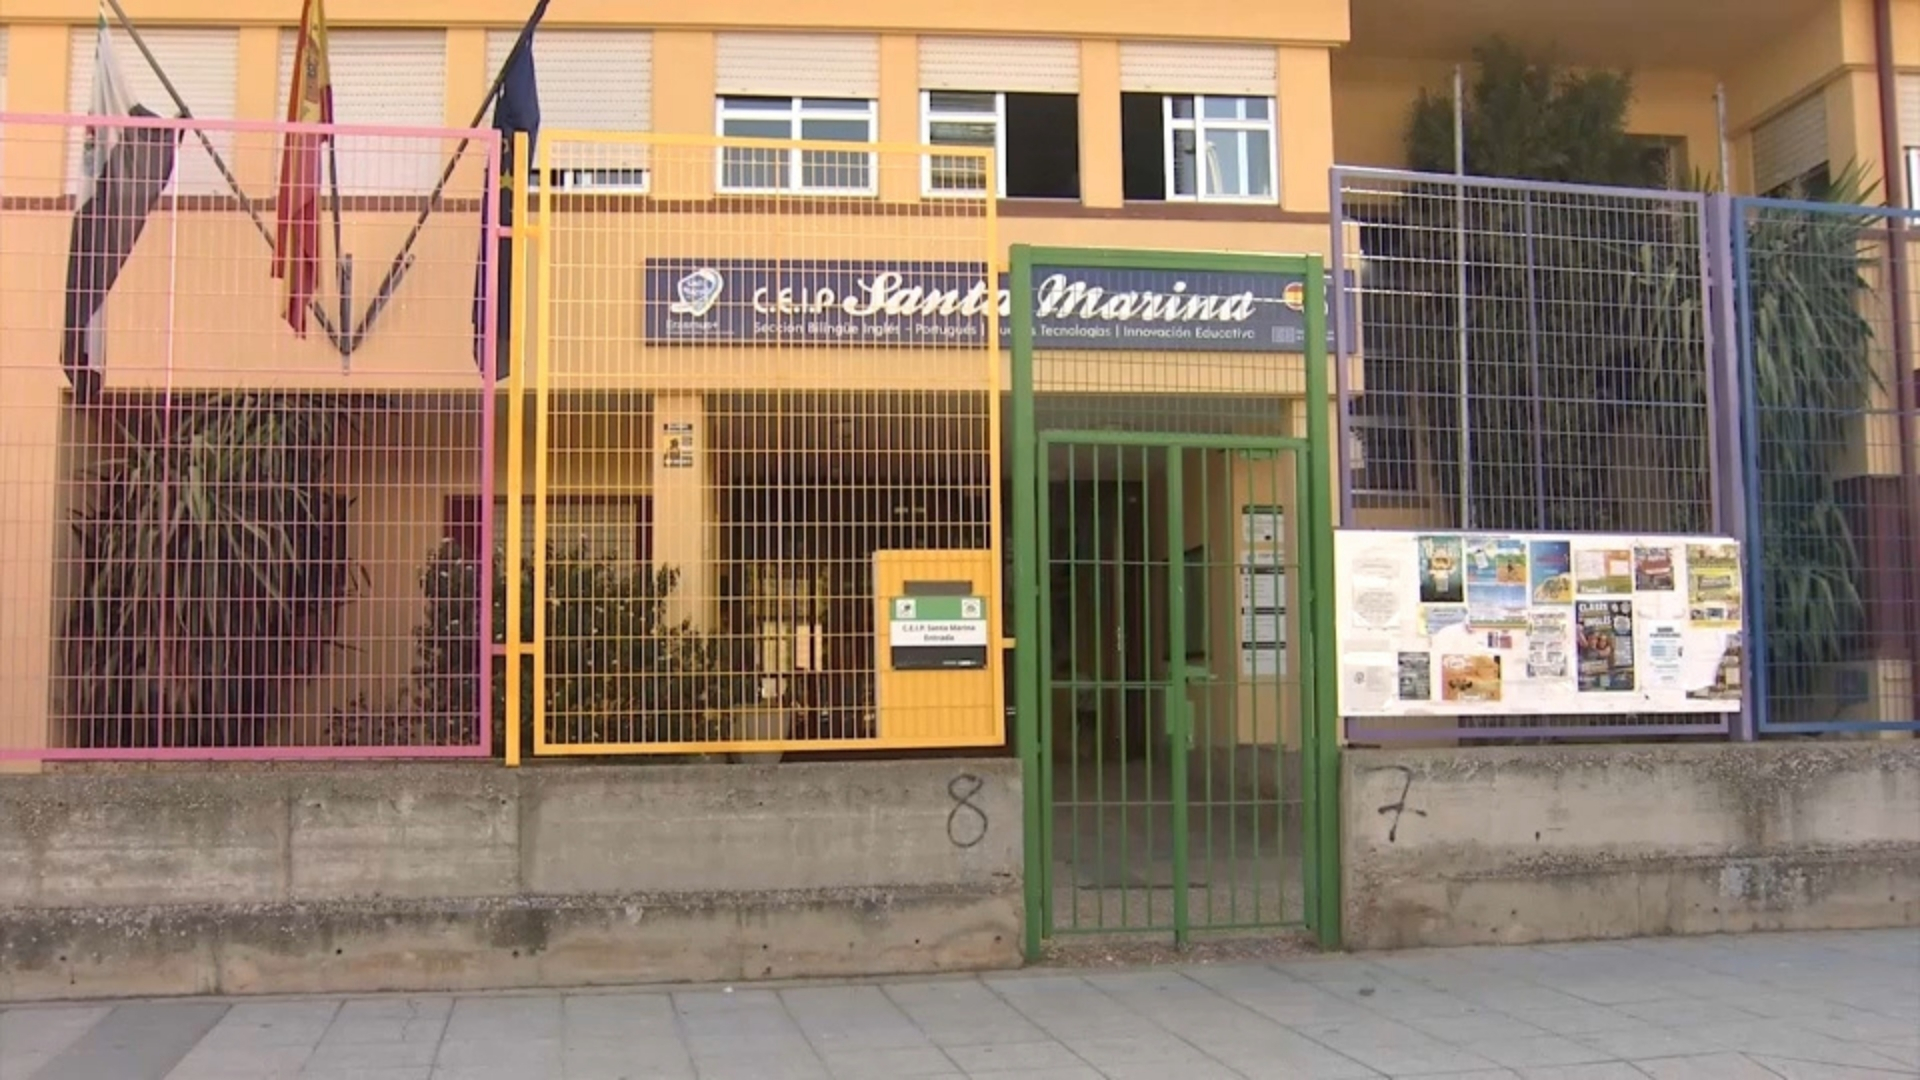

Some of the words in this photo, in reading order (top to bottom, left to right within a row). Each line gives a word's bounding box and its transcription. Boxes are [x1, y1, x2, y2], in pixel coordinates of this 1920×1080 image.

[842, 271, 1011, 317] Santa
[1035, 273, 1257, 322] Marina
[1123, 325, 1191, 339] Innovación
[1195, 327, 1255, 340] Educativa
[927, 624, 949, 632] Santa
[950, 624, 976, 632] Marina
[946, 772, 989, 849] 8
[1362, 765, 1428, 843] 7
